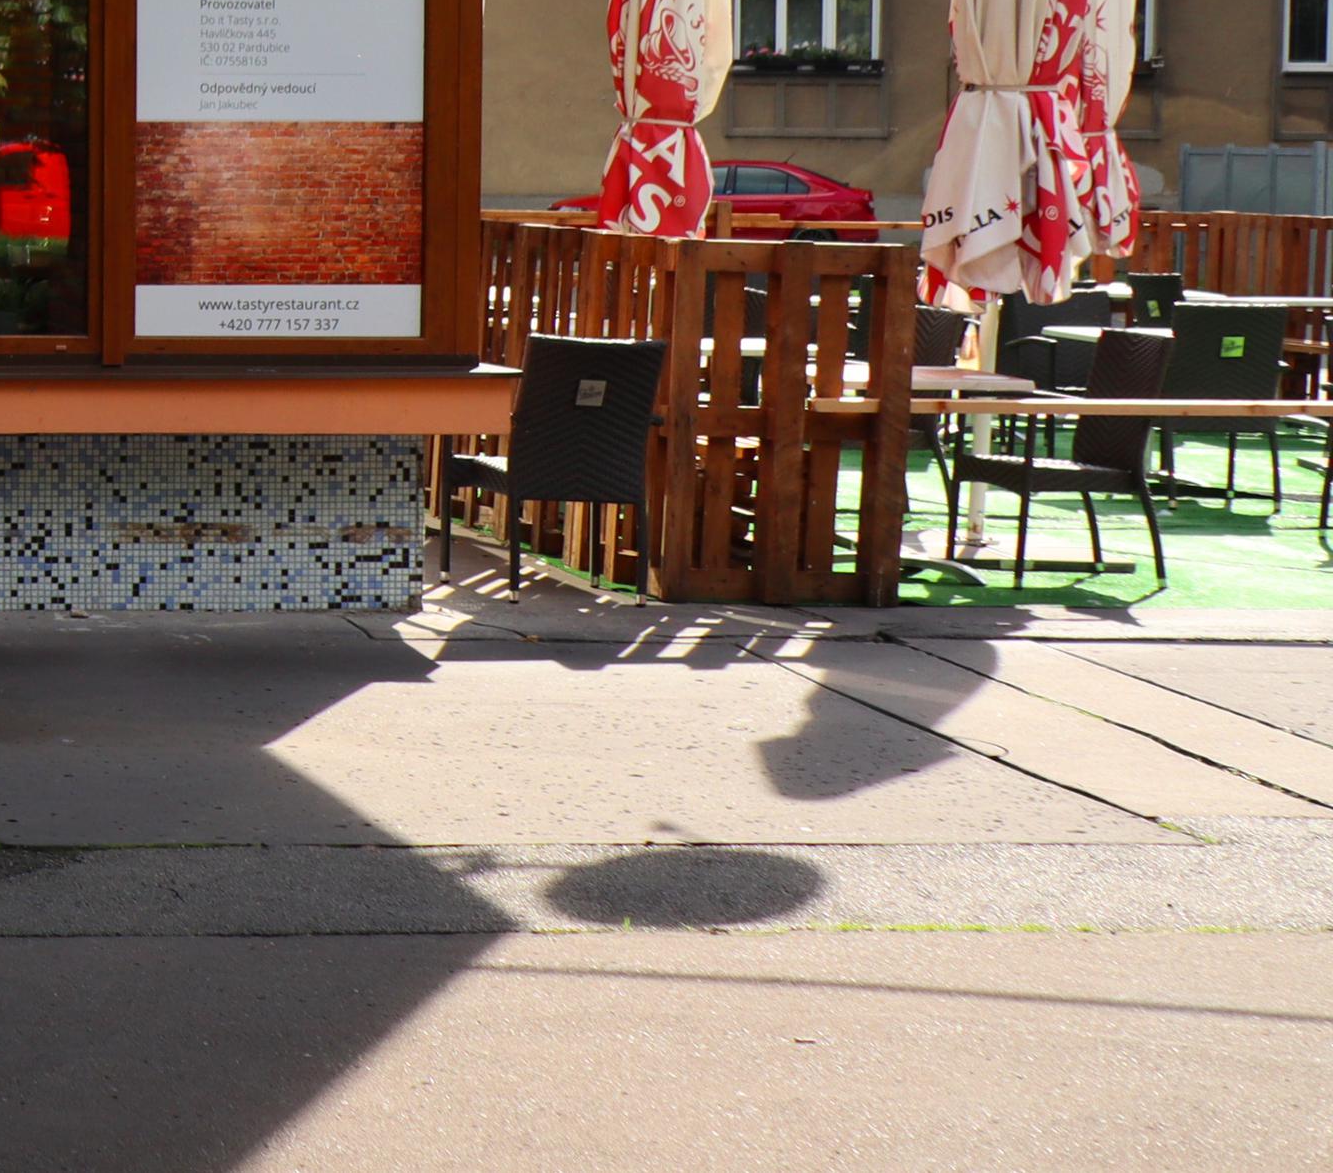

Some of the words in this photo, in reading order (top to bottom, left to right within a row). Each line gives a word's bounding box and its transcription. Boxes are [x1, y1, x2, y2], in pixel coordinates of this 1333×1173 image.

[200, 0, 275, 10] Provozovatel
[201, 16, 215, 25] Do
[228, 16, 254, 28] Tasty
[201, 28, 254, 39] Havlíčkova
[256, 29, 276, 39] 445
[201, 43, 220, 53] 530
[223, 43, 235, 53] 02
[239, 42, 290, 53] Pardubice
[200, 83, 268, 96] Odpovědný
[271, 83, 316, 94] vedoucí
[199, 300, 359, 313] www.tastyrestaurant.cz
[219, 319, 252, 330] +420
[257, 319, 281, 330] 777
[286, 319, 310, 331] 157
[315, 318, 339, 331] 337
